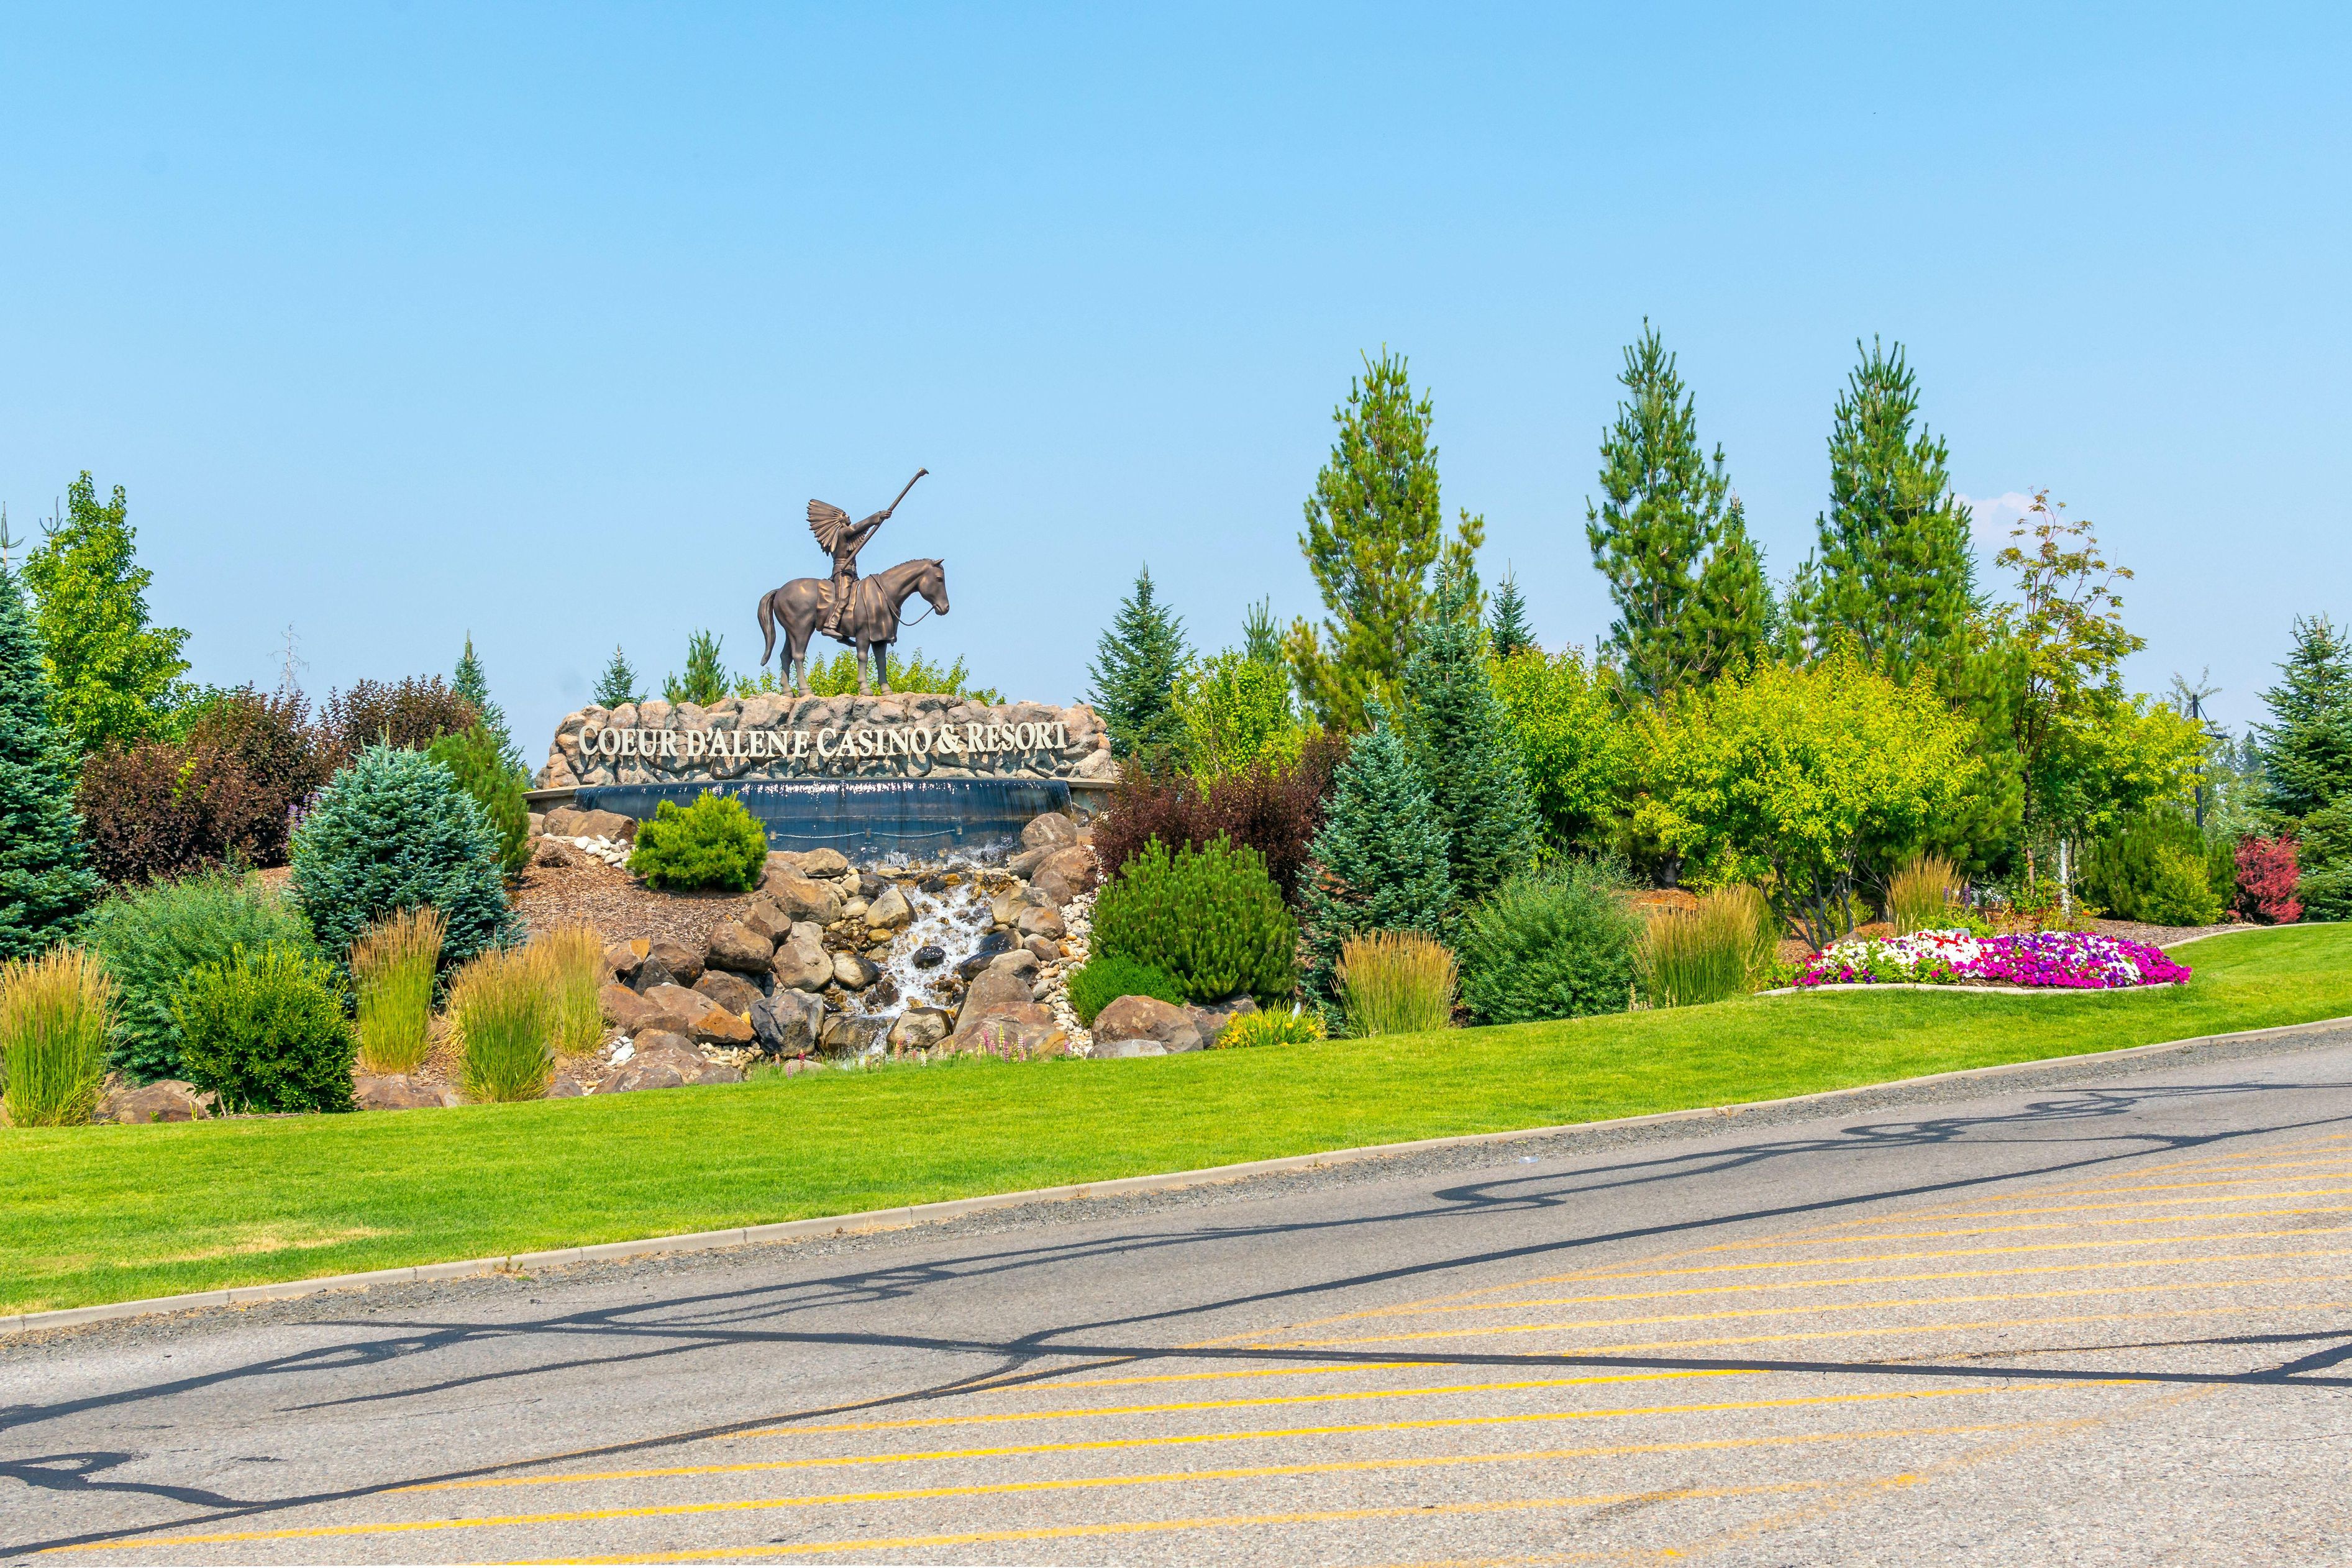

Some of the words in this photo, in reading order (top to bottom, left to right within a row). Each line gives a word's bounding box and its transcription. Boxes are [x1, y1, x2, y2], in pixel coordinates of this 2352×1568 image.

[578, 725, 679, 757] COEUR
[686, 727, 809, 758] D'ALENE
[816, 727, 932, 757] CASINO
[937, 724, 962, 754] &
[966, 721, 1069, 753] RESORT
